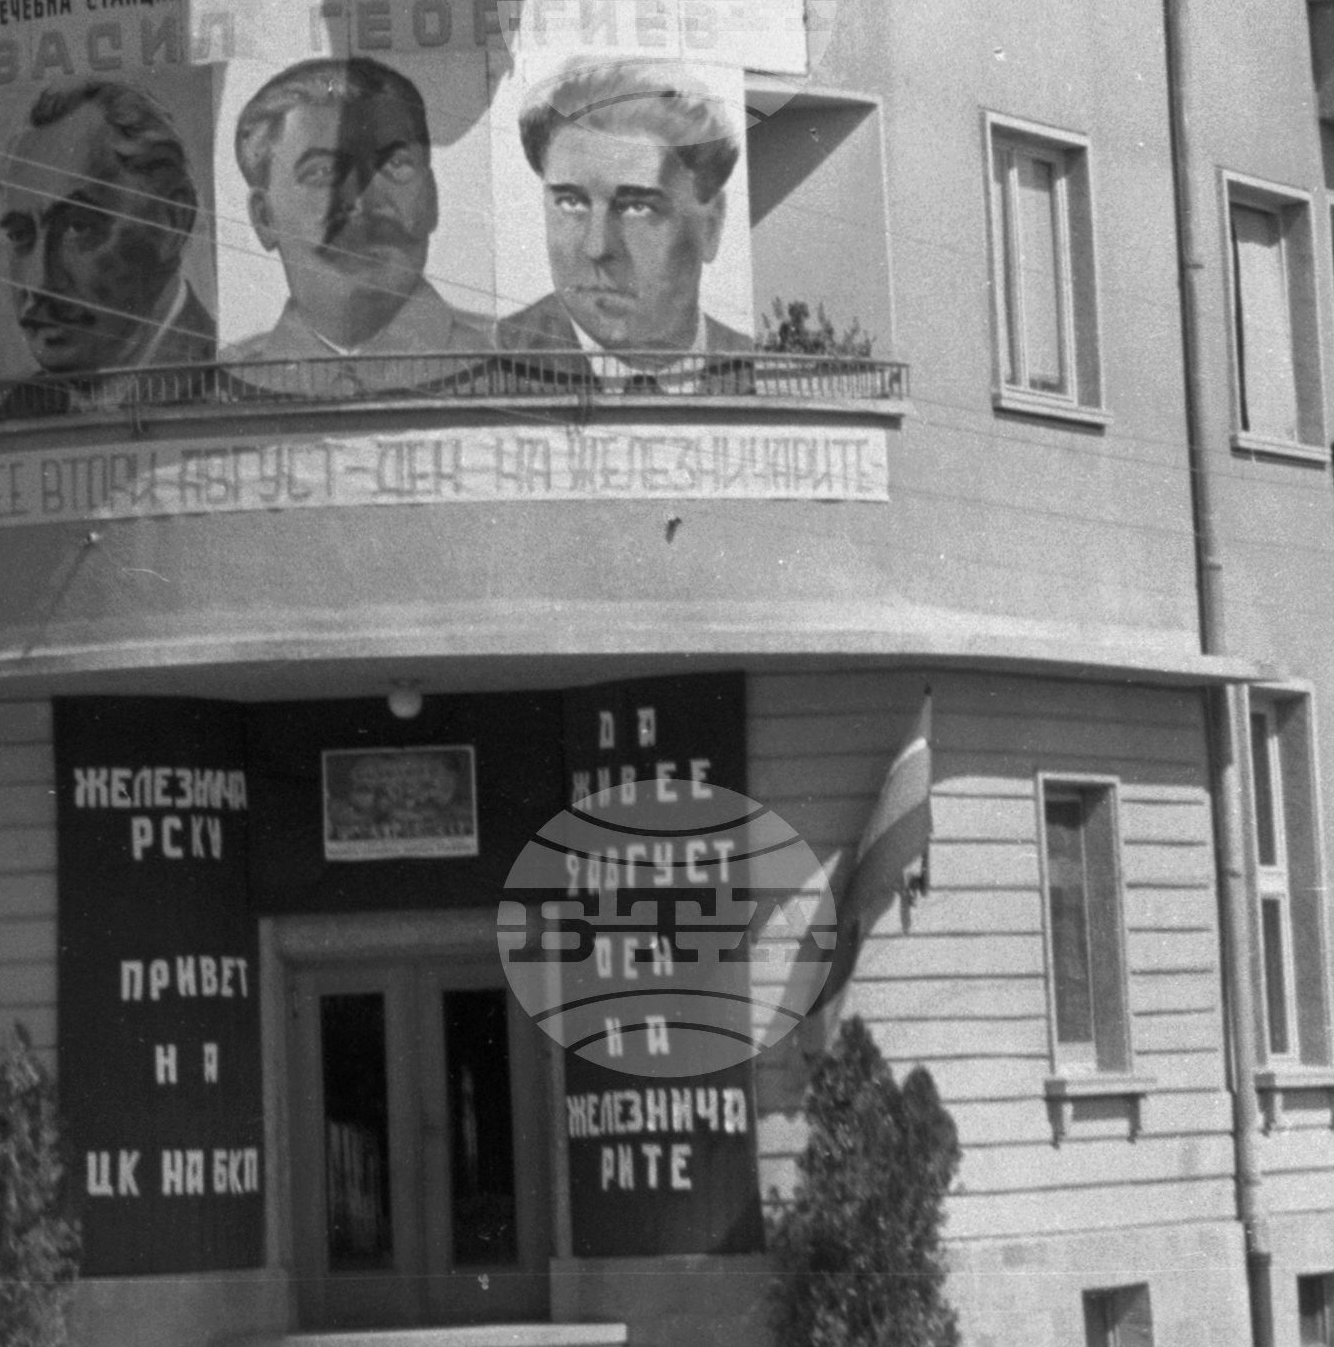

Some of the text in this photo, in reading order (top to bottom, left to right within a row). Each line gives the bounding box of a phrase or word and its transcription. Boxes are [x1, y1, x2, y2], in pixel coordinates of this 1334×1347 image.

[120, 955, 248, 1001] ПРИВЕТ
[566, 1086, 748, 1139] ЖЕЛЕЗНИЧА
[87, 1148, 258, 1197] ЦК НА БКП
[600, 1143, 693, 1193] РИТЕ
